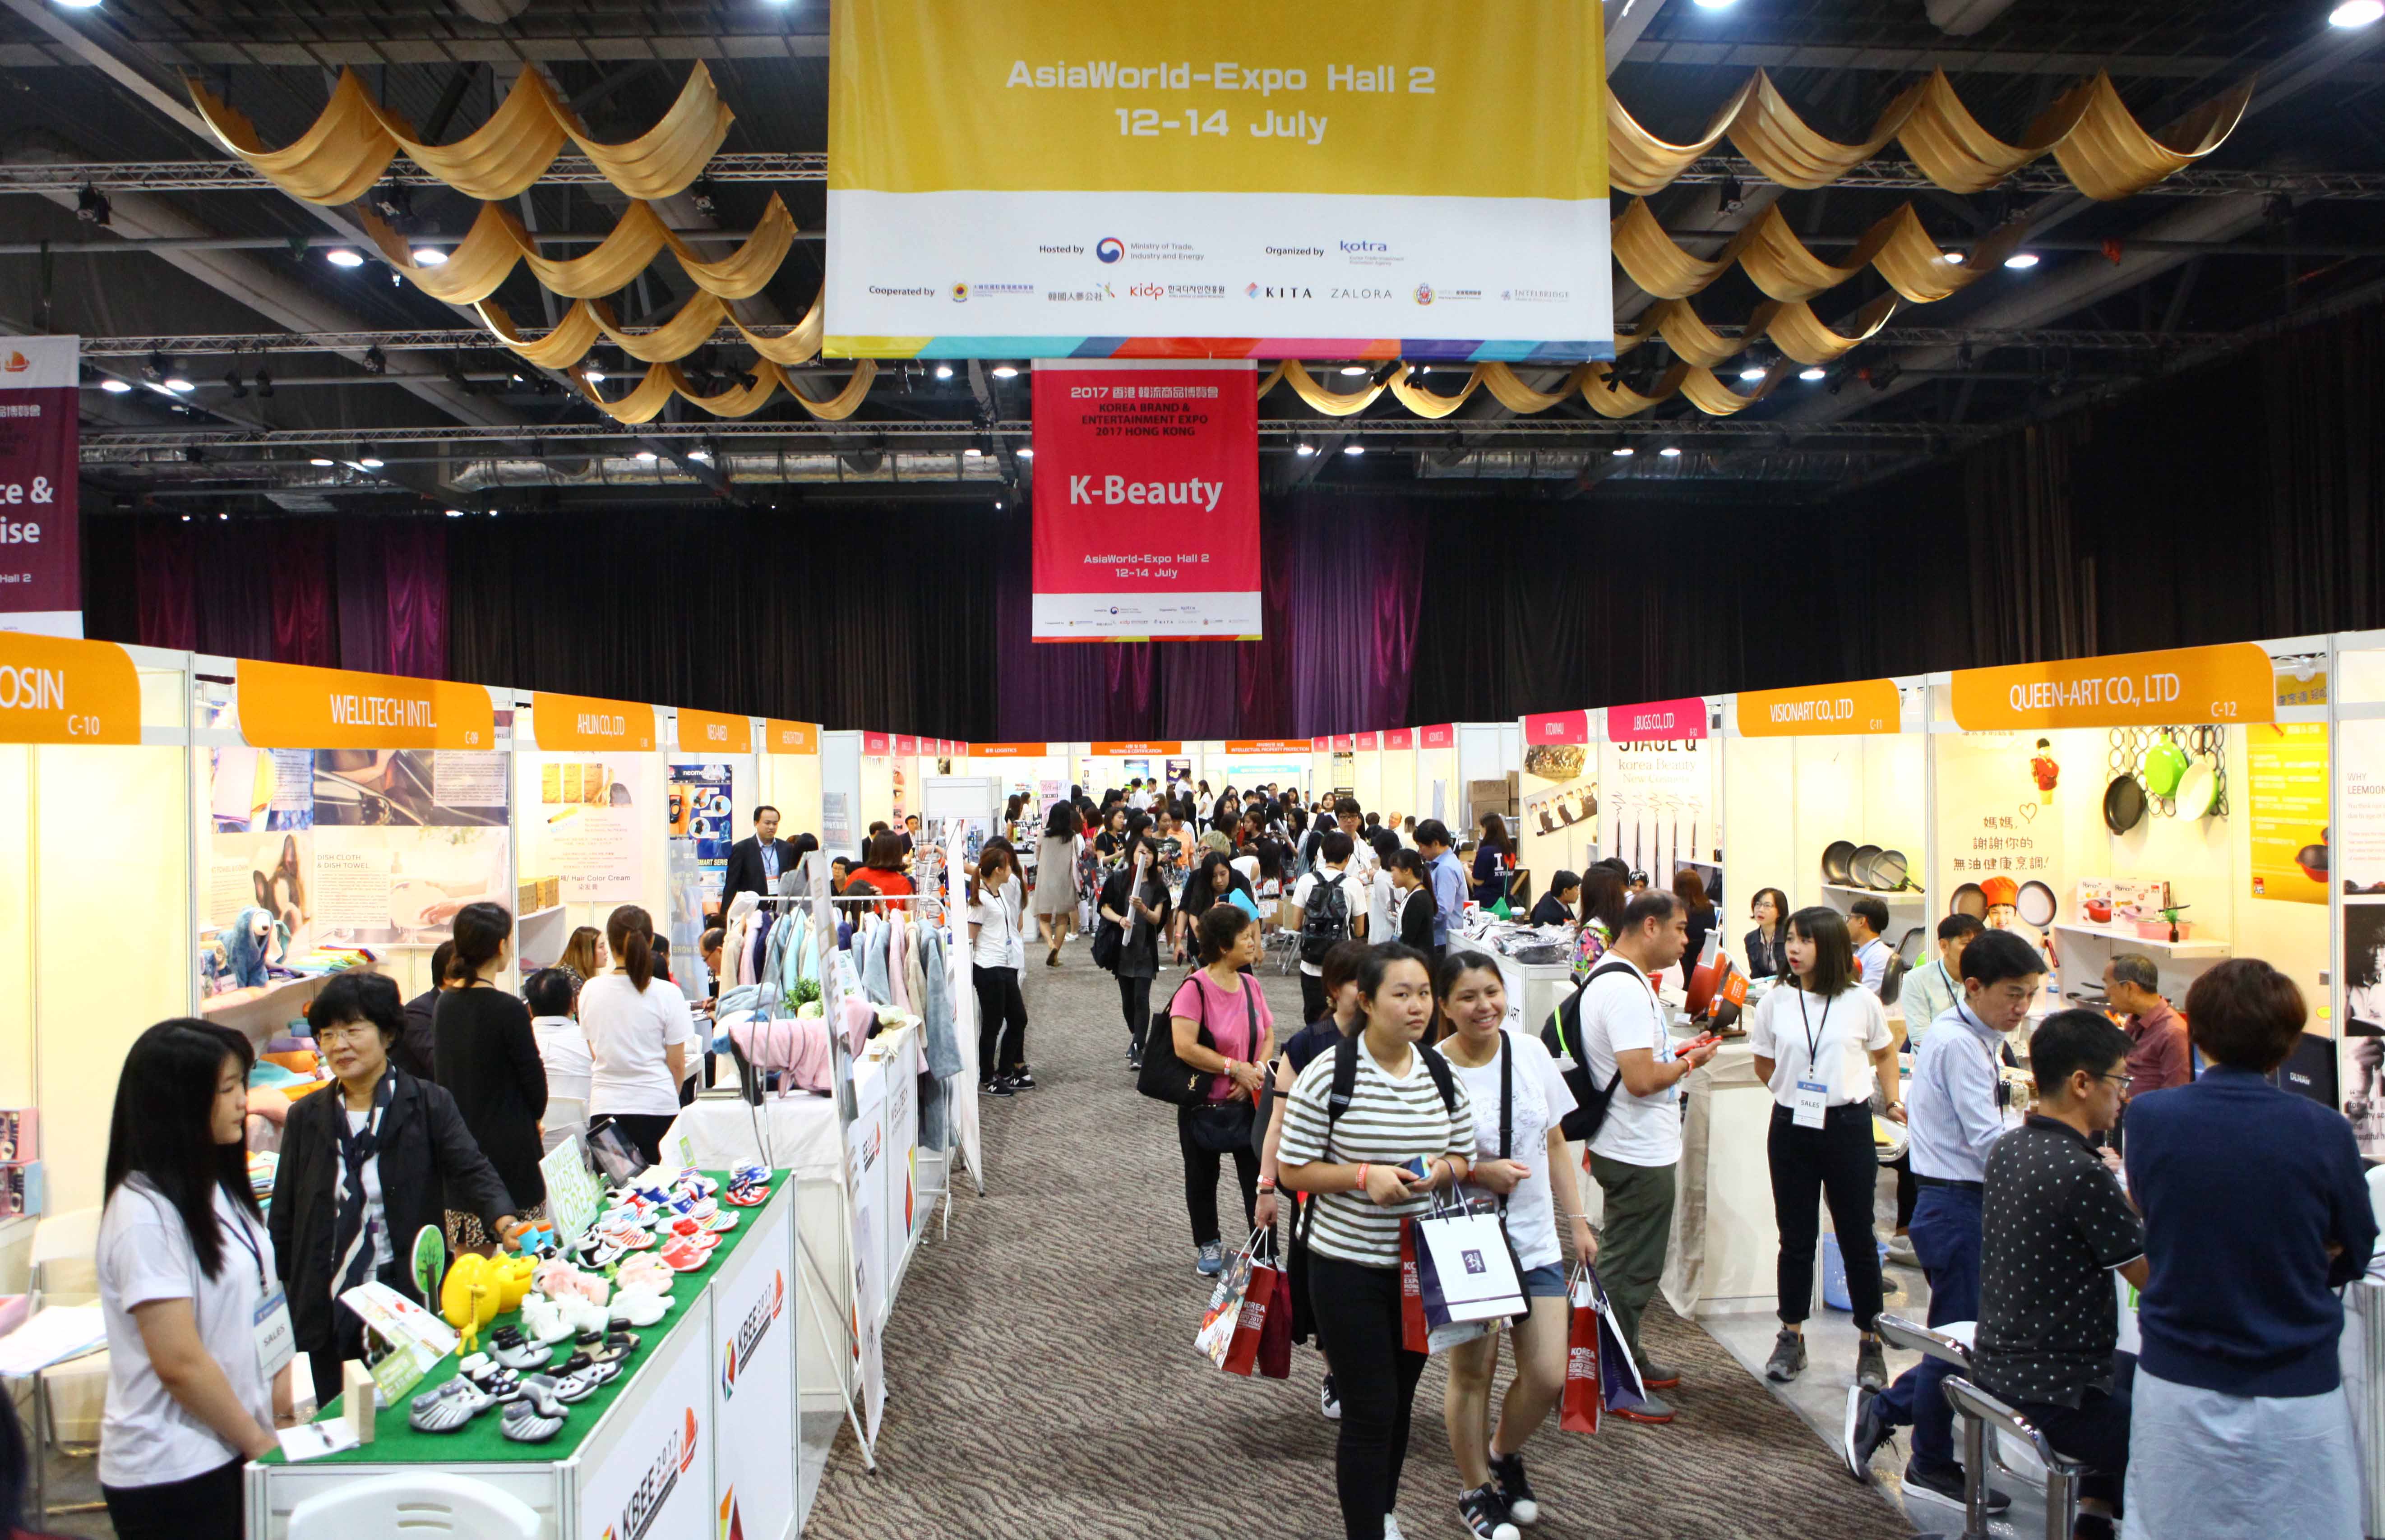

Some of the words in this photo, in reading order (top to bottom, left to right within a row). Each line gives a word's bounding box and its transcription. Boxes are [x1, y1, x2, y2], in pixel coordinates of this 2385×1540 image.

[1006, 60, 1307, 97] AsiaWorld-Expo
[1328, 64, 1394, 92] Hall
[1409, 66, 1435, 94] 2
[1115, 108, 1229, 137] 12-14
[1250, 110, 1328, 145] July
[1040, 245, 1071, 254] Hosted
[1073, 245, 1084, 255] by
[1266, 246, 1311, 257] Organized
[1313, 248, 1324, 258] by
[1340, 240, 1387, 253] kotra
[1131, 253, 1160, 261] Industry
[1179, 254, 1205, 262] Energy
[869, 286, 921, 296] Cooperated
[924, 287, 935, 297] by
[1130, 283, 1164, 301] kidp
[1266, 287, 1312, 298] KITA
[1331, 288, 1392, 299] ZALORA
[1071, 387, 1109, 399] 2017
[1113, 387, 1135, 398] 香港
[1099, 403, 1136, 412] KOREA
[1140, 403, 1179, 412] BRAND
[1182, 403, 1190, 412] &
[1082, 415, 1174, 424] ENTERTAINMENT
[1178, 415, 1208, 424] EXPO
[1096, 427, 1121, 436] 2017
[1125, 427, 1159, 436] HONG
[1163, 427, 1195, 436] KONG
[30, 476, 53, 503] &
[1070, 475, 1223, 513] K-Beauty
[1084, 555, 1172, 565] AsiaWorld-Expo
[1177, 554, 1197, 563] Hall
[1201, 554, 1210, 563] 2
[0, 574, 20, 583] Hall
[23, 573, 32, 582] 2
[1115, 569, 1149, 578] 12-14
[1155, 569, 1178, 579] July
[2010, 679, 2103, 711] QUEEN-ART
[2106, 676, 2141, 708] CO.,
[2145, 673, 2180, 702] LTD
[330, 694, 404, 727] WELLTECH
[408, 700, 437, 728] INTL.
[1770, 701, 1815, 722] VISIONART
[1816, 700, 1834, 722] CO.,
[1836, 698, 1853, 719] LTD
[2211, 701, 2237, 718] C-12
[68, 714, 100, 737] C-10
[578, 714, 599, 734] AHLIN
[613, 715, 626, 735] LTD
[1664, 712, 1674, 729] LTD
[1870, 719, 1882, 730] C-11
[465, 731, 478, 745] C-09
[1618, 758, 1652, 770] korea
[1656, 758, 1696, 771] Beauty
[2348, 773, 2367, 781] WHY
[1973, 836, 2033, 850] 謝謝你的
[1494, 853, 1504, 871] I
[1953, 856, 2049, 871] 無油健康烹調!
[1801, 1100, 1820, 1108] SALES
[1243, 1300, 1265, 1313] KOREA
[1250, 1314, 1263, 1323] 2017
[263, 1324, 285, 1347] SALES
[738, 1305, 757, 1359] KBEE
[1571, 1347, 1595, 1359] KOREA
[623, 1465, 655, 1540] KBEE
[657, 1429, 677, 1476] 2017
